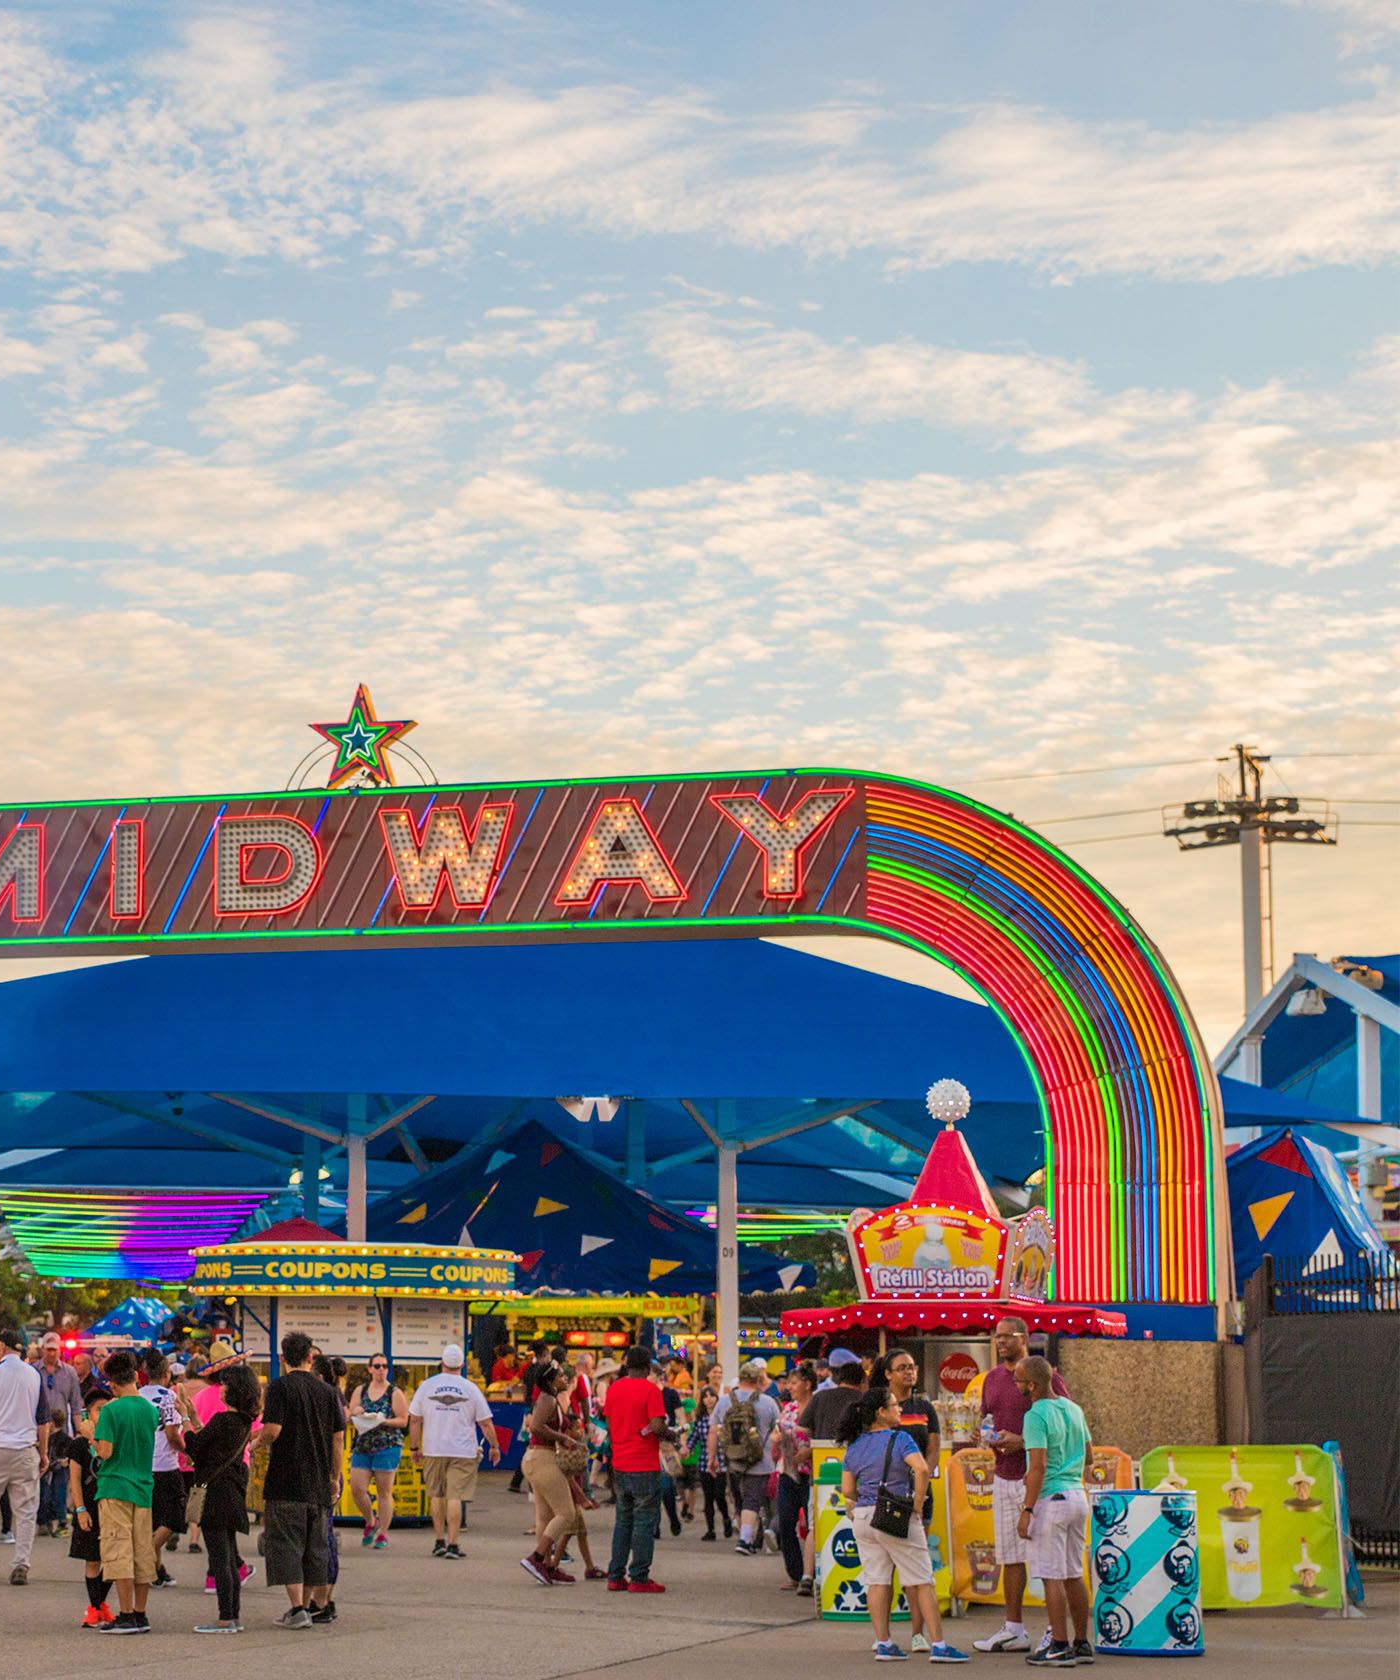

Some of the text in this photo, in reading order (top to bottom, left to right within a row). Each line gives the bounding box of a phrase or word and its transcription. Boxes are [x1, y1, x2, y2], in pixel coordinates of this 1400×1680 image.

[265, 1261, 387, 1280] COUPONS
[430, 1264, 508, 1284] COUPONS
[878, 1268, 990, 1289] Refill Station
